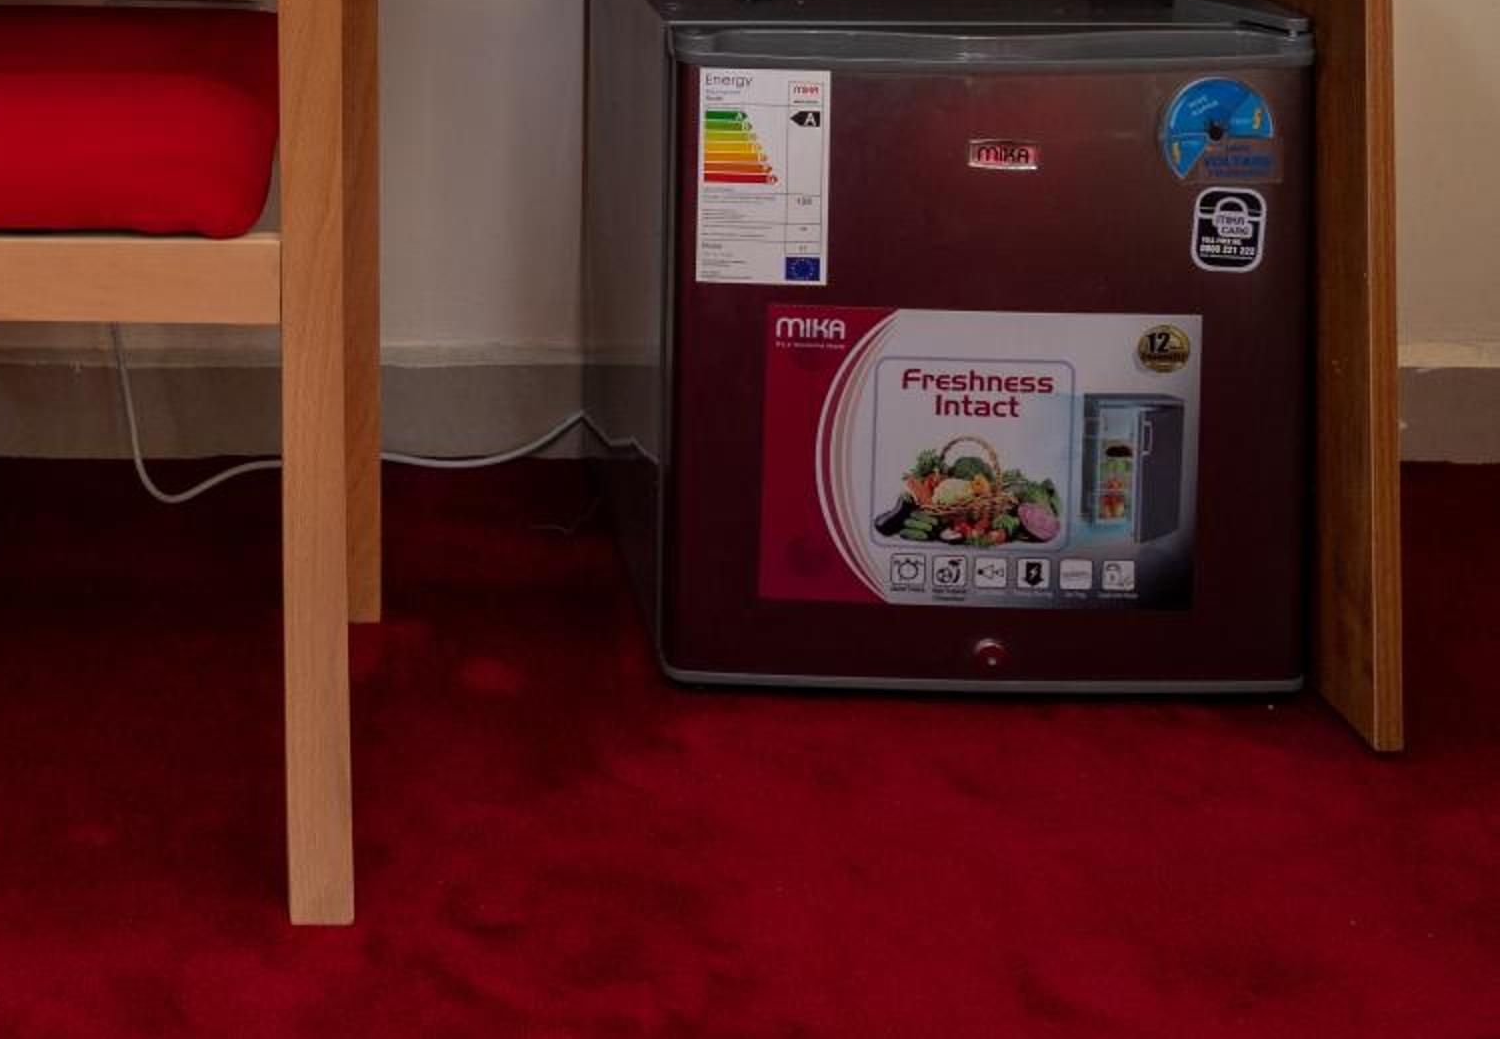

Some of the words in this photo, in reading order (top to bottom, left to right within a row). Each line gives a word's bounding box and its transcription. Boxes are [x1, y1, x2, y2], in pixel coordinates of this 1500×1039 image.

[705, 73, 753, 88] Energy
[804, 113, 817, 126] A
[977, 146, 1029, 163] MIKA
[775, 317, 846, 340] MIKA
[1146, 332, 1170, 353] 12
[901, 368, 1055, 394] Freshness
[934, 394, 1021, 418] Intact
